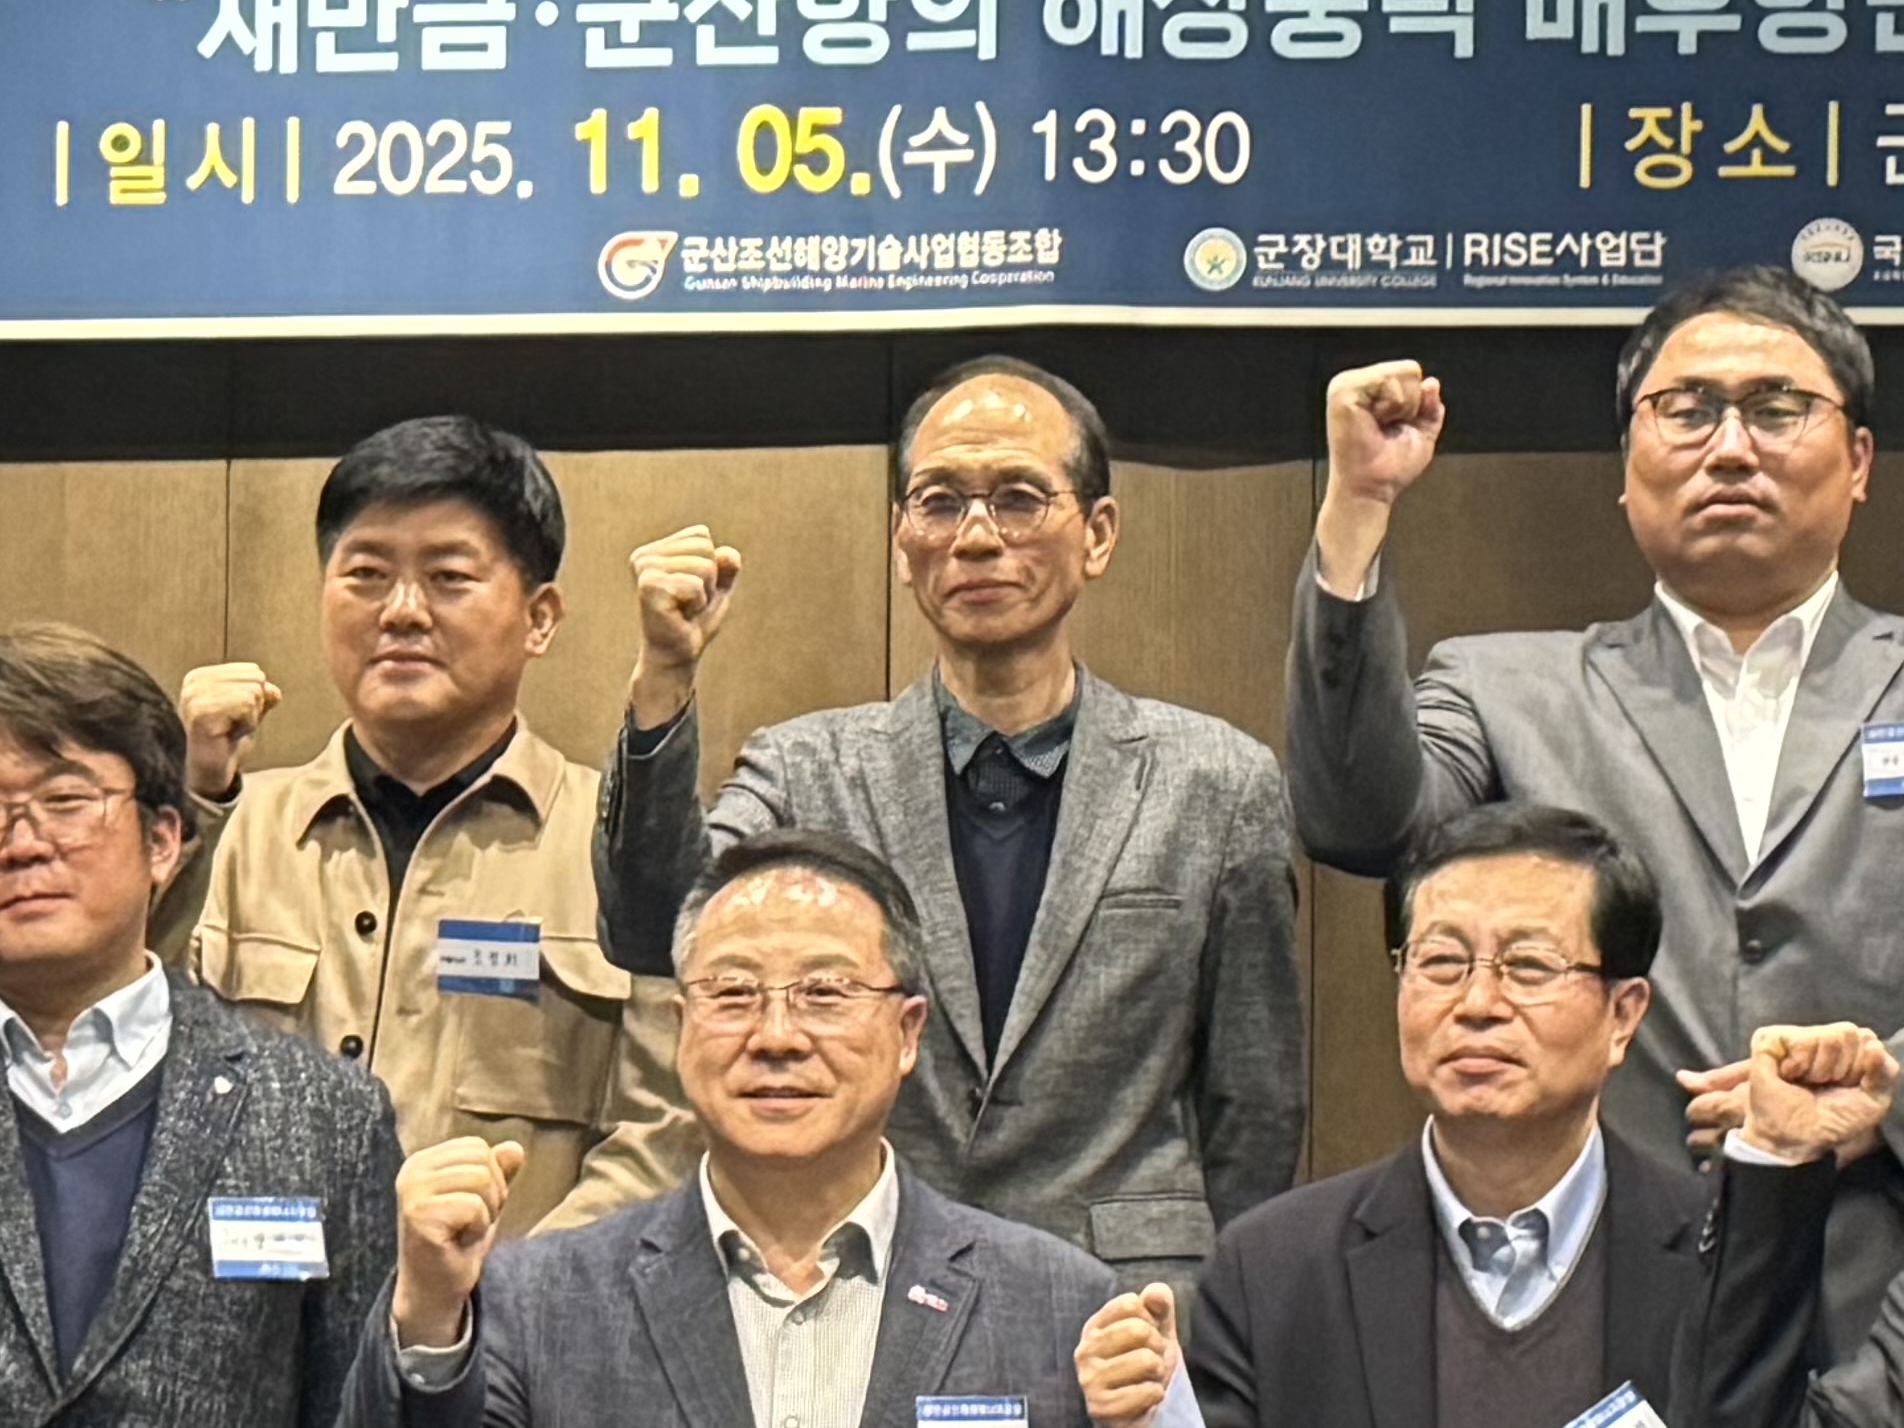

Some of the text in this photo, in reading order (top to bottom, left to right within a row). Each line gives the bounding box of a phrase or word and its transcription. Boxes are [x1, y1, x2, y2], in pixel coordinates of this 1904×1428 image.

[334, 119, 533, 199] 2025.
[575, 107, 699, 198] 11.
[1032, 109, 1250, 184] 13:30
[681, 228, 1062, 273] 군산조선해양기술사업협동조합
[1253, 231, 1666, 270] 군장대학교 RISE사업단
